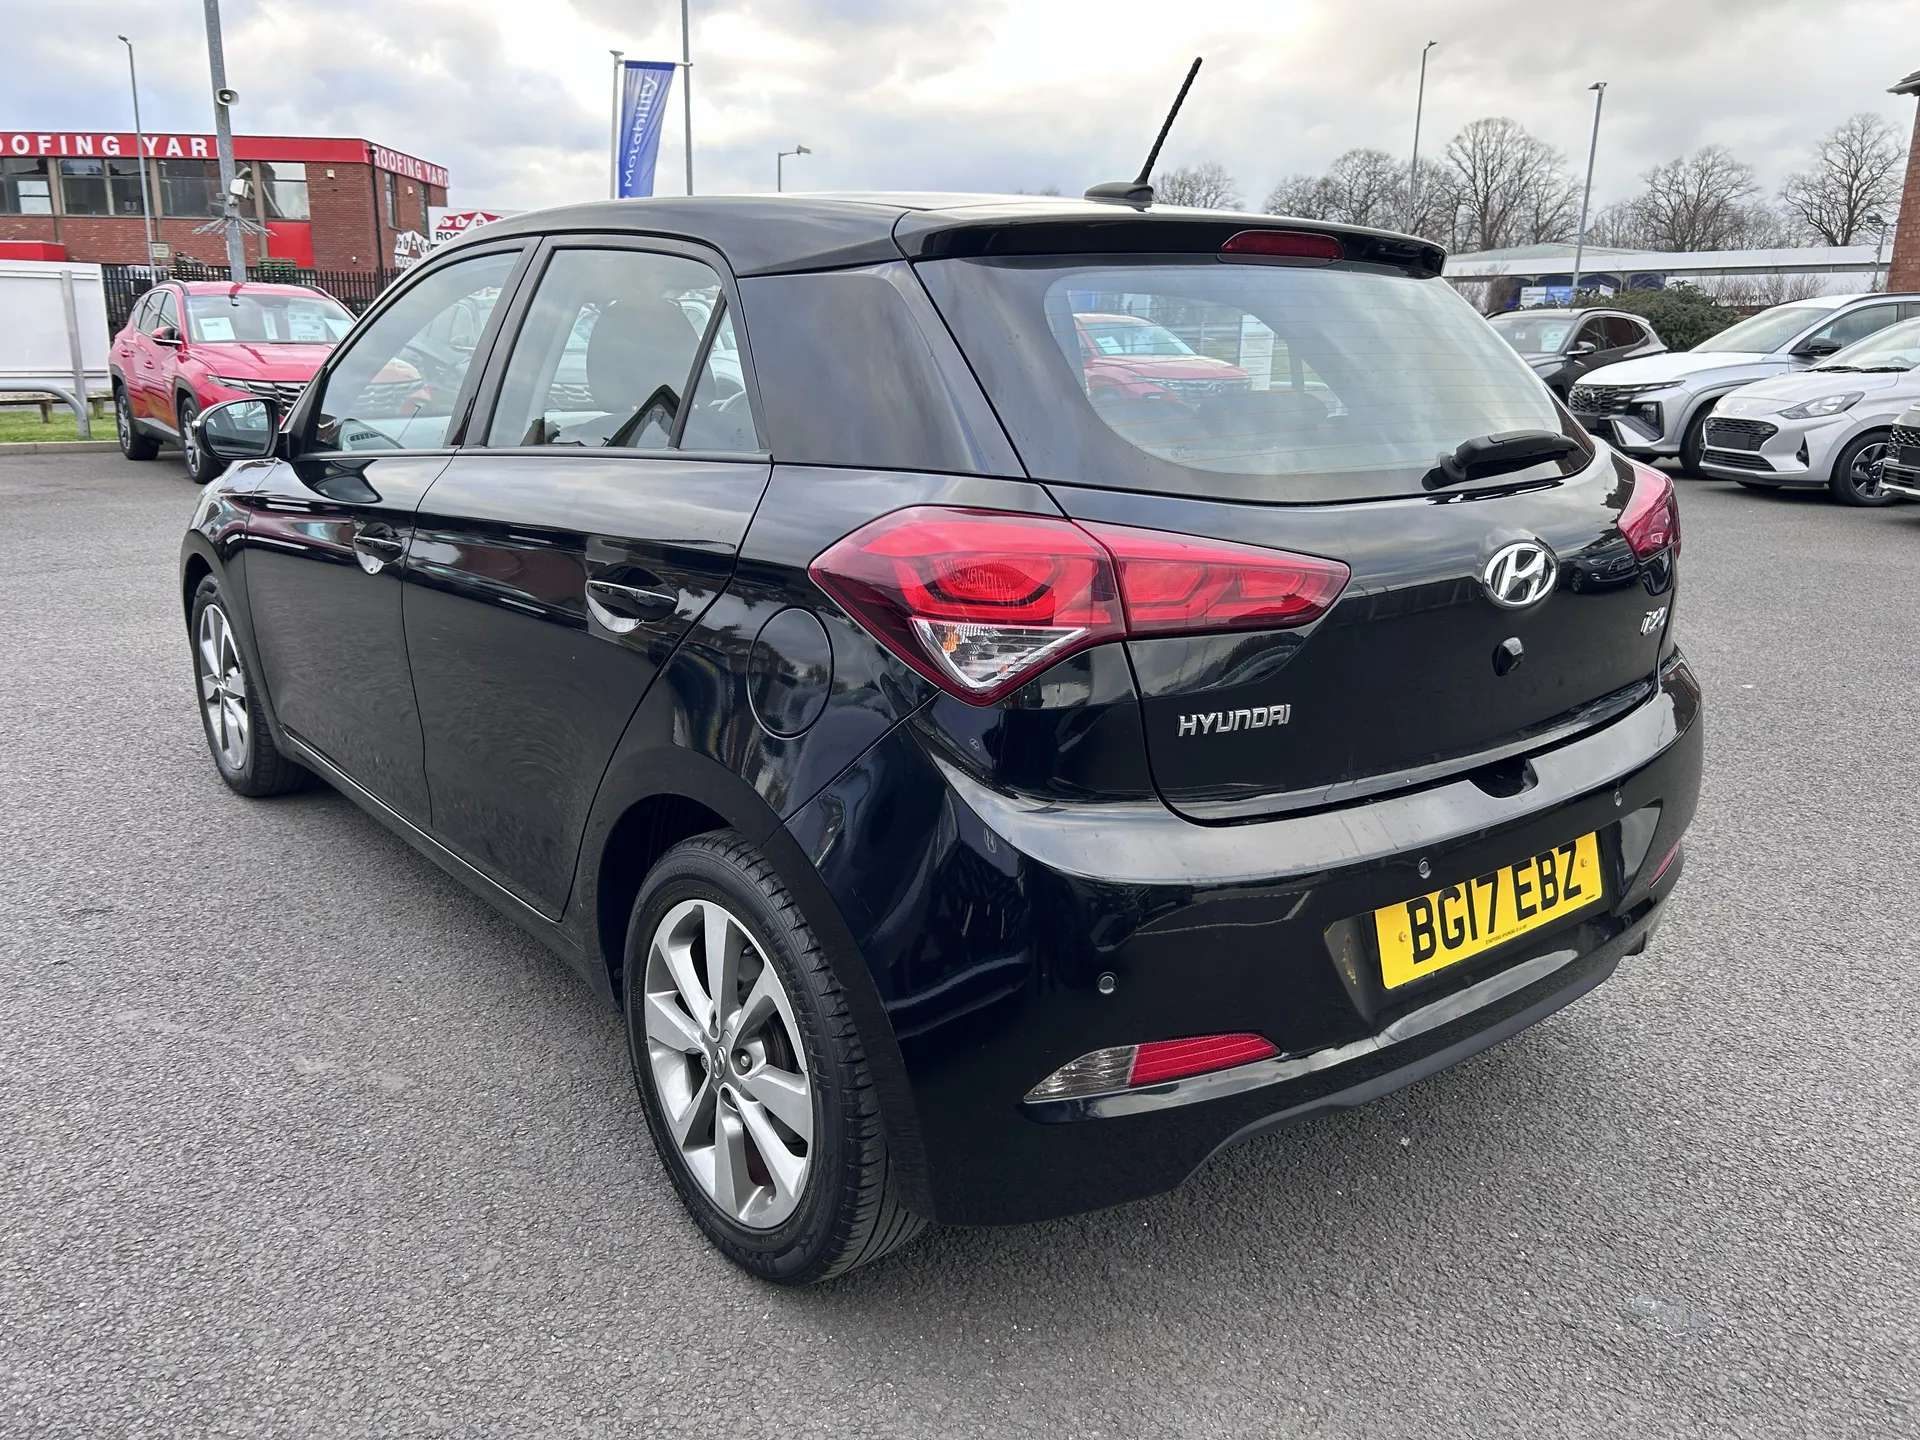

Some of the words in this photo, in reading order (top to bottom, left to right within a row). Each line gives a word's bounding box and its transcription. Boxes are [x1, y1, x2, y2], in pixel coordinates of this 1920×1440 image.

[0, 134, 120, 157] OFING
[142, 136, 220, 158] YAR
[624, 76, 658, 187] Motability
[374, 146, 422, 179] ROOFING
[1178, 703, 1292, 737] HYUNDAI
[1405, 870, 1499, 965] BG17
[1511, 839, 1582, 922] EBZ
